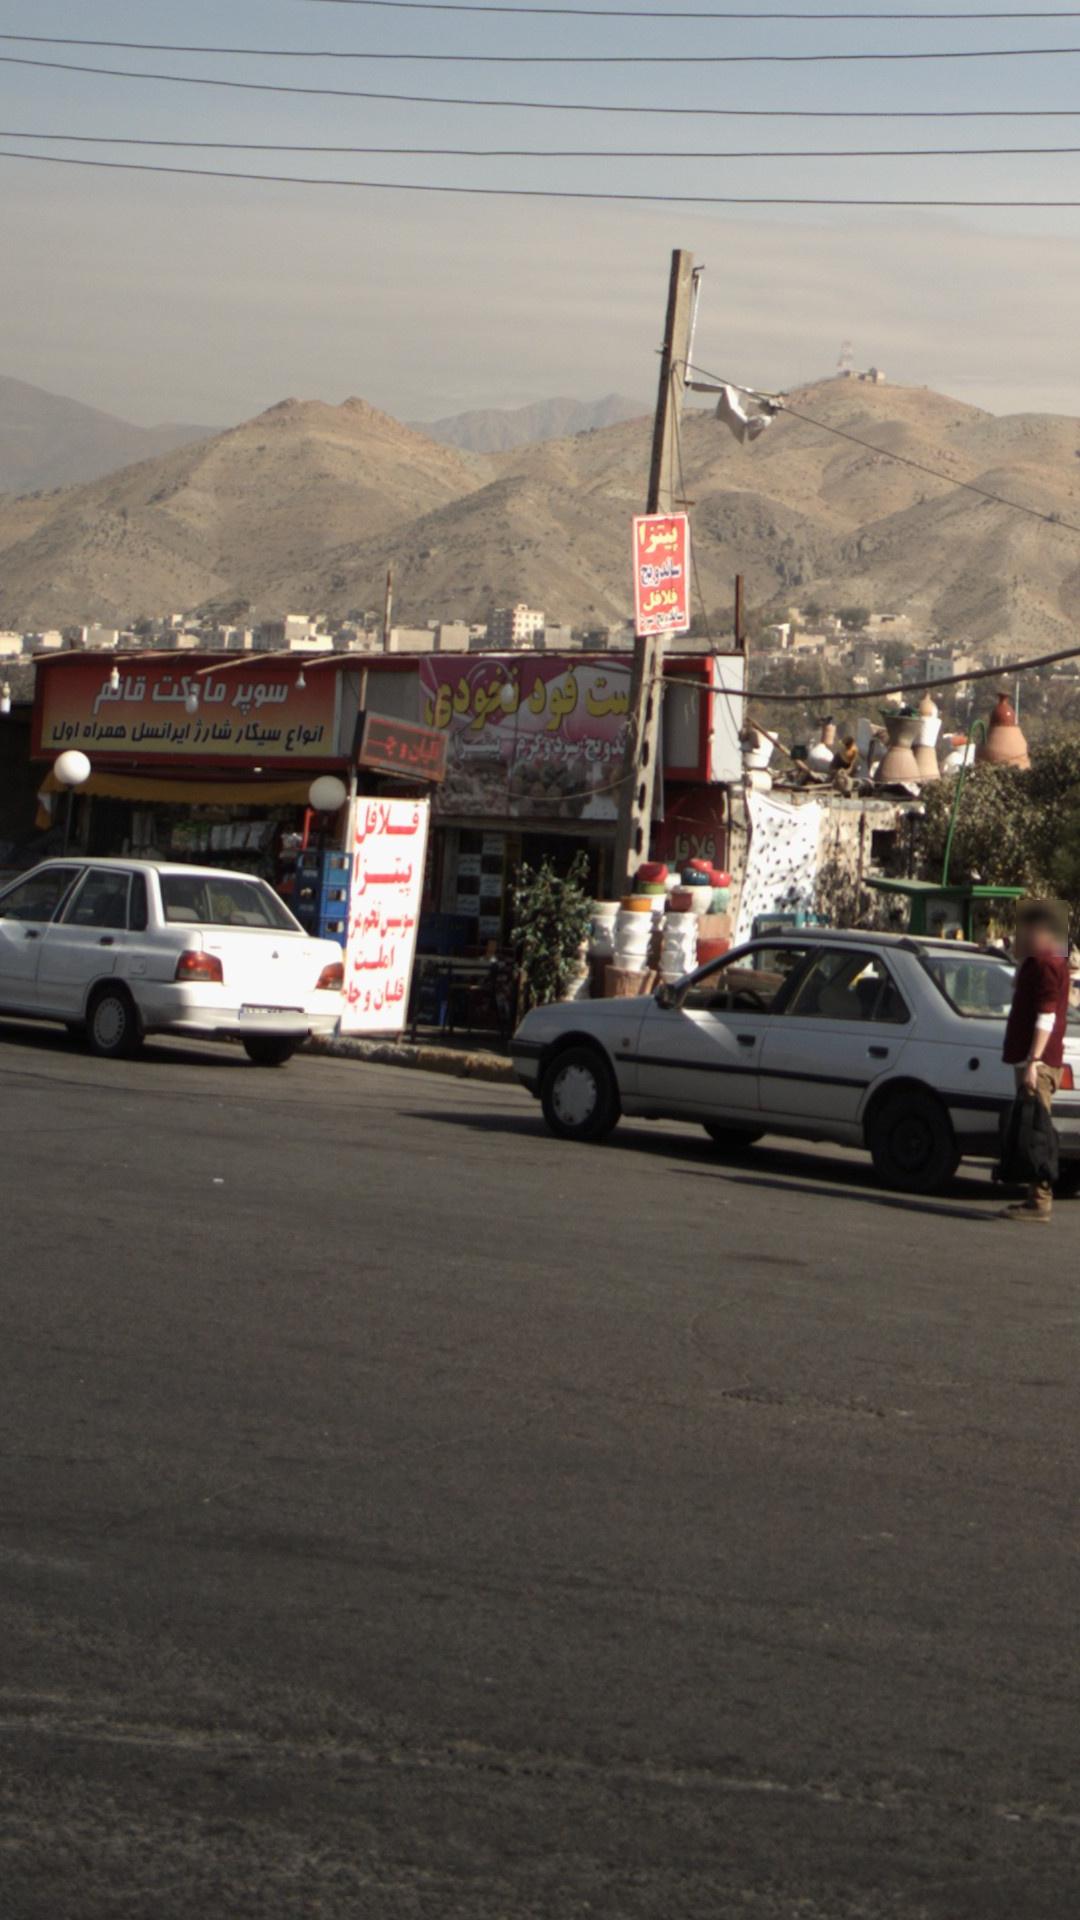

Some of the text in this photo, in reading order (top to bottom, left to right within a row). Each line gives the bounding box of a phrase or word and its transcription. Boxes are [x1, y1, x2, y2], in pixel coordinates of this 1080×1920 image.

[638, 523, 678, 553] پیتزا
[643, 587, 678, 611] فلافل
[232, 683, 288, 715] سوپر
[528, 663, 577, 731] فود
[584, 675, 629, 717] ست
[51, 720, 78, 740] اول
[83, 722, 127, 741] همراه
[131, 721, 190, 744] ایرانسل
[193, 718, 233, 743] شارژ
[285, 725, 324, 751] انواع
[355, 801, 419, 844] فلافل
[353, 852, 413, 896] پیتزا
[364, 990, 371, 1011] و
